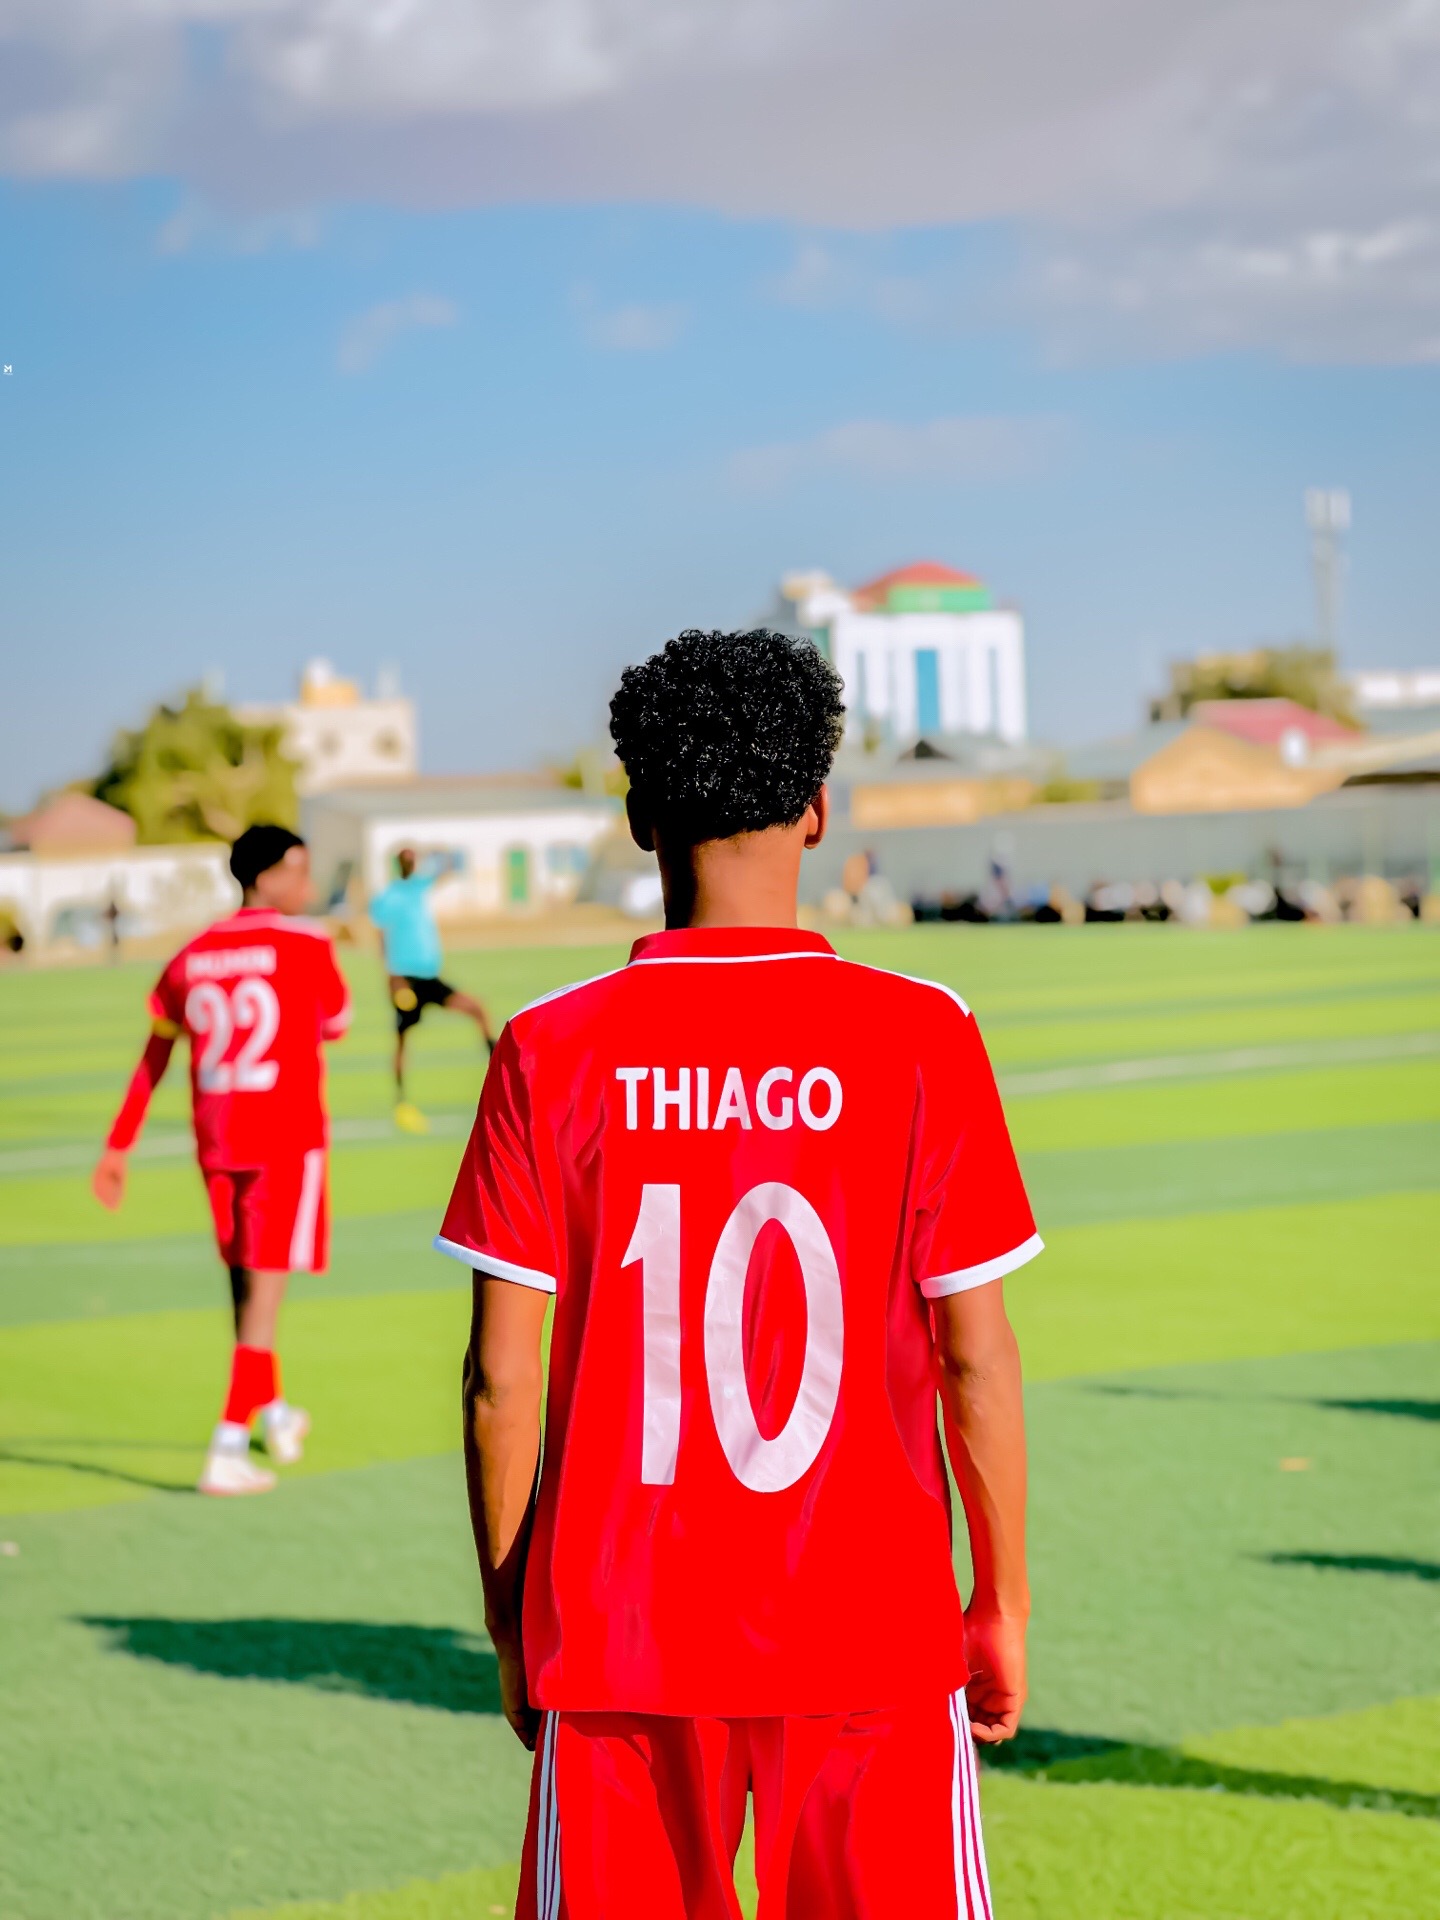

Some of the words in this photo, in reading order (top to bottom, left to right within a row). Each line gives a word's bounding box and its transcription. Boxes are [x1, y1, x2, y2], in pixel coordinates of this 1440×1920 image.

[185, 976, 280, 1094] 22
[615, 1066, 843, 1131] THIAGO
[619, 1181, 844, 1493] 10
